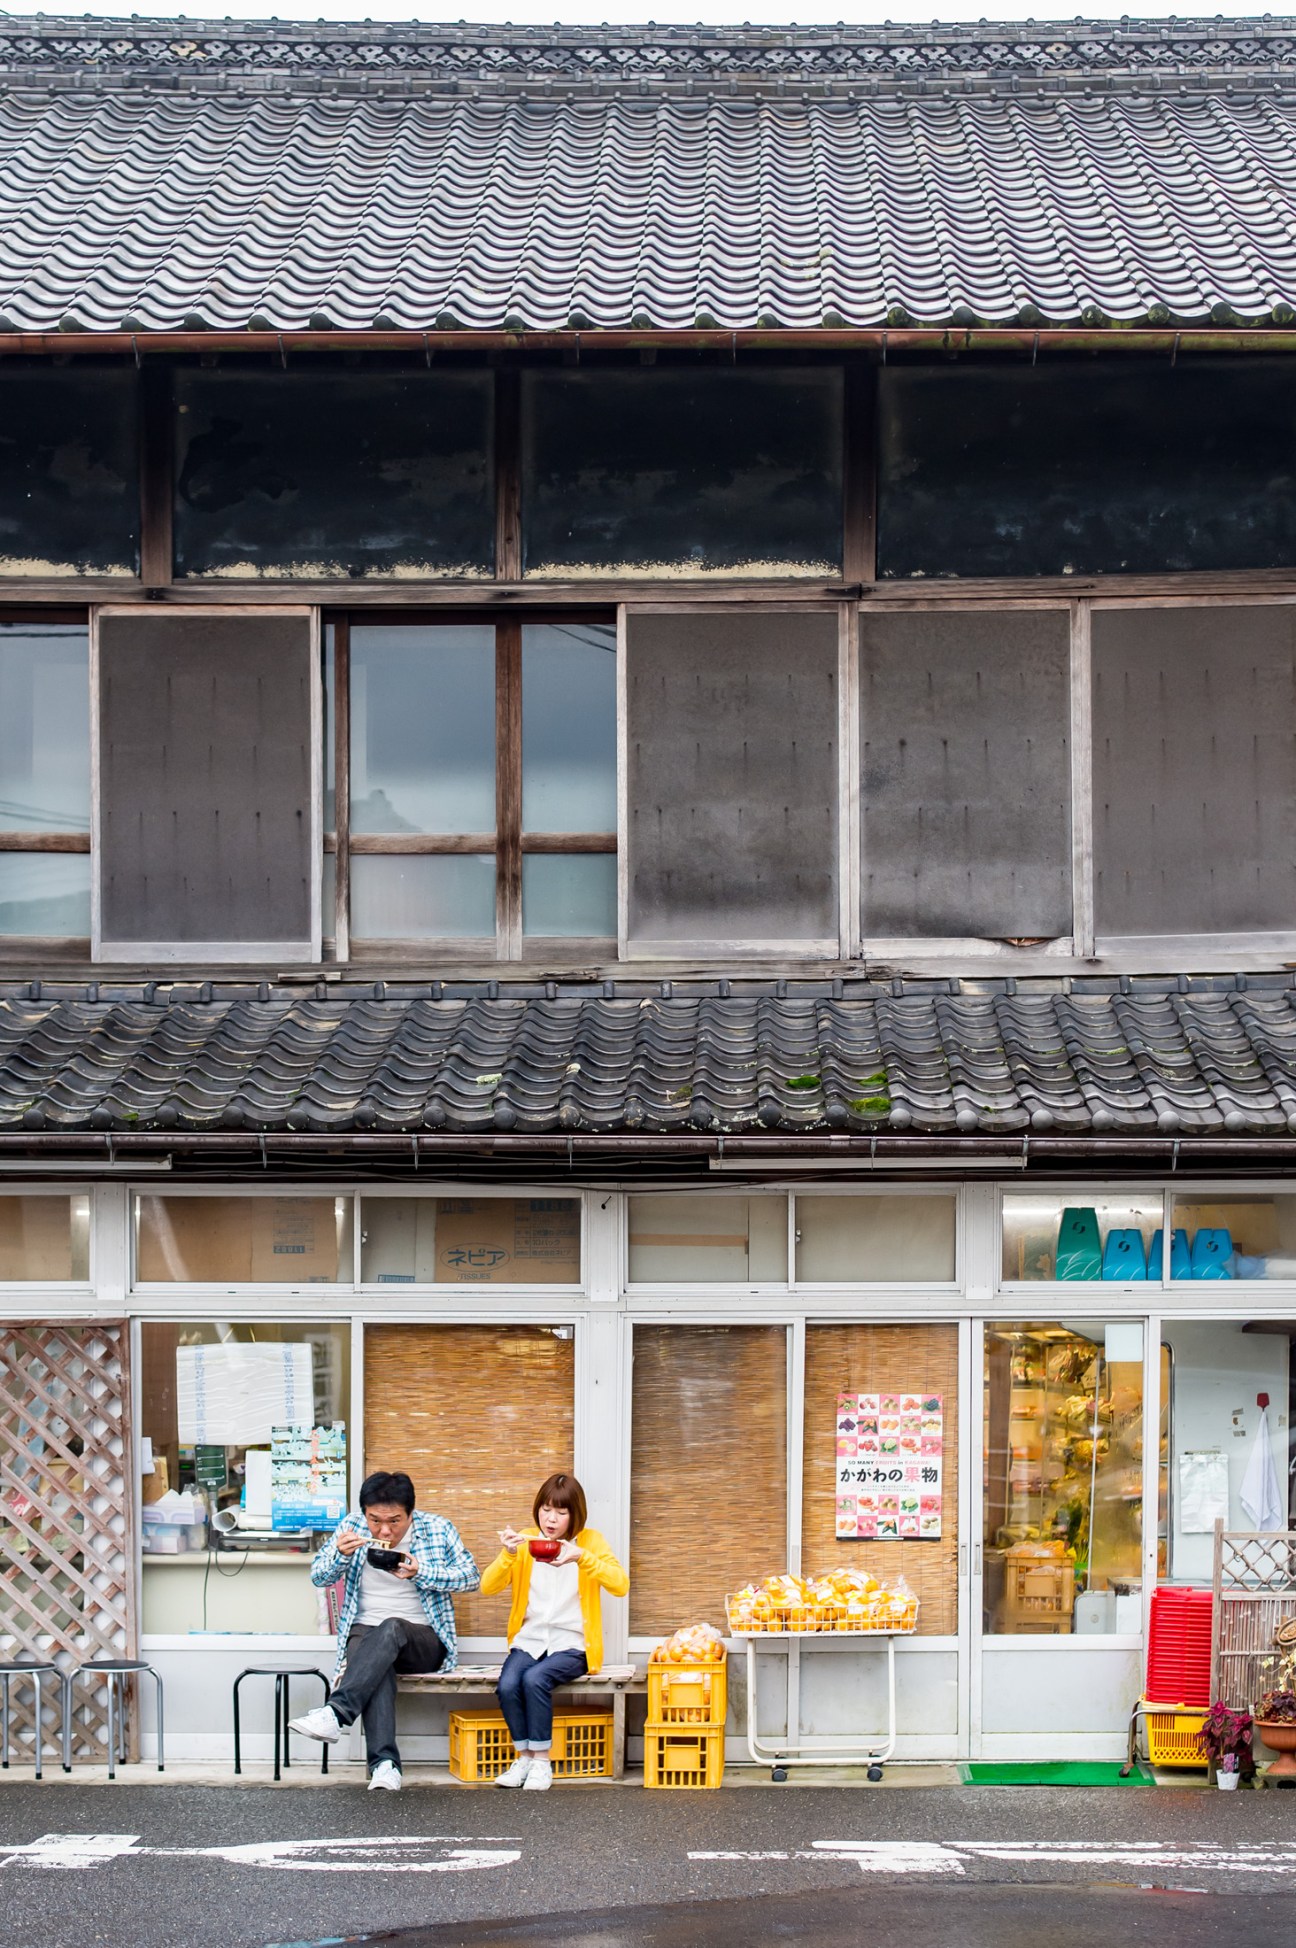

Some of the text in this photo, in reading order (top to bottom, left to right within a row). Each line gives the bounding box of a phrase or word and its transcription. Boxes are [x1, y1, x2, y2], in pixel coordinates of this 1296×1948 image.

[447, 1248, 506, 1266] ネピア
[840, 1467, 938, 1483] かがわの果物
